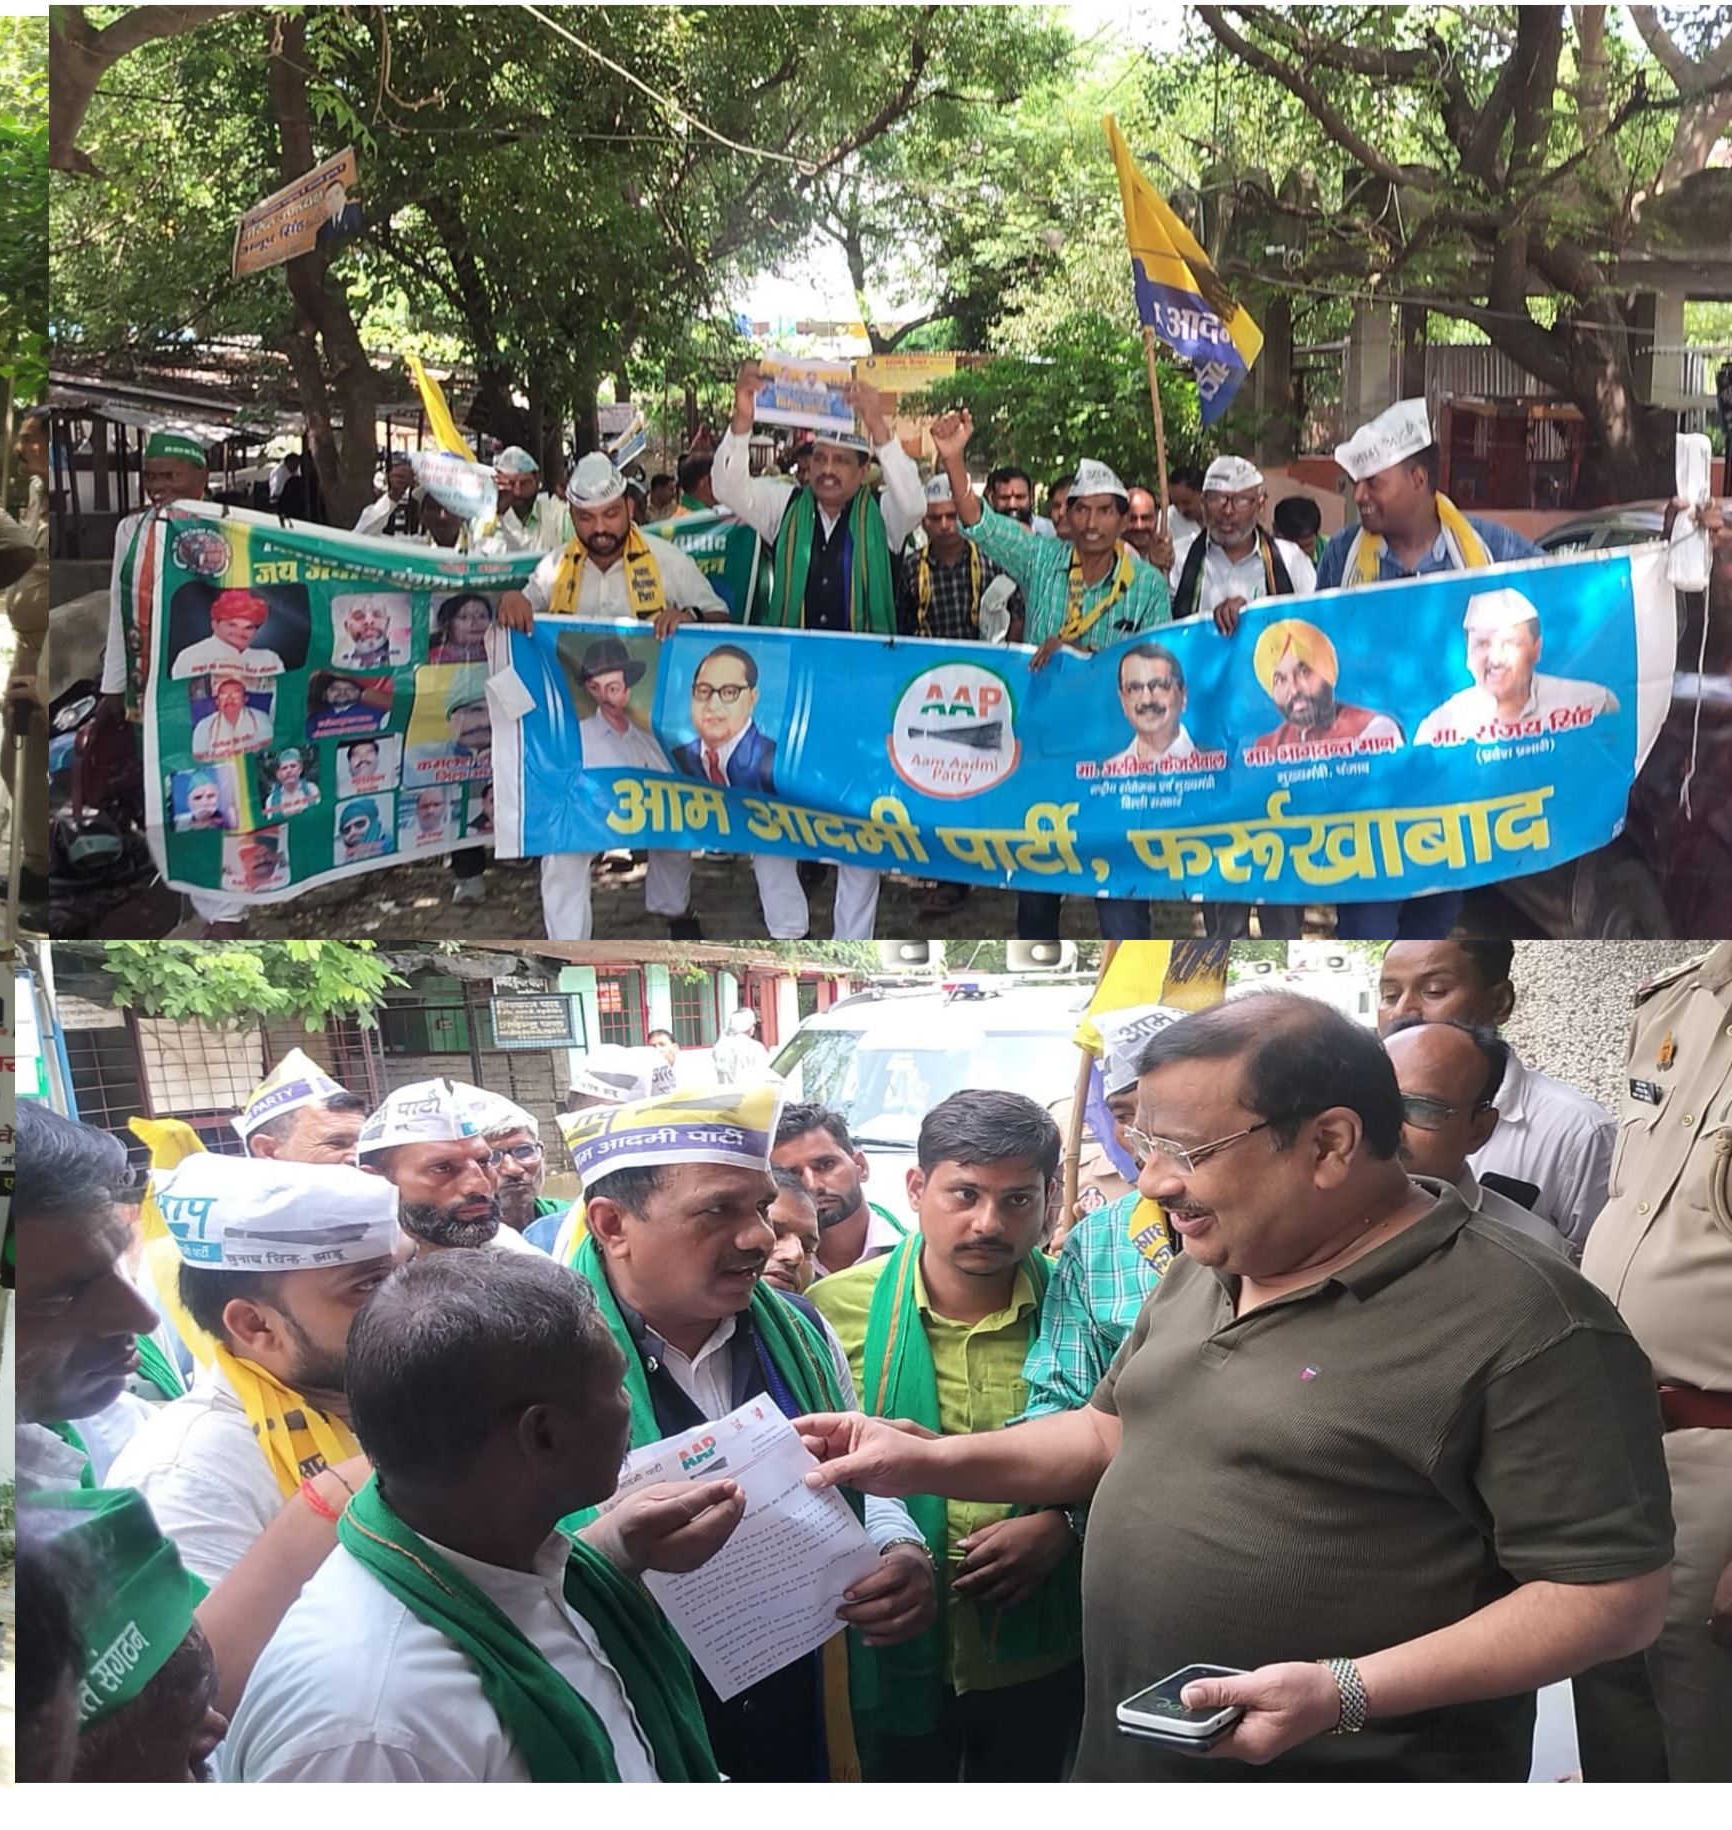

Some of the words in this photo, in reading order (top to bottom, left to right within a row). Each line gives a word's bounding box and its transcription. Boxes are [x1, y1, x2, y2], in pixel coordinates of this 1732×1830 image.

[253, 560, 299, 585] जय
[920, 683, 1003, 718] AAP
[1432, 726, 1467, 749] मा.
[1474, 717, 1544, 744] संजय
[1548, 706, 1596, 735] सिंह
[1358, 735, 1400, 756] मान
[910, 753, 946, 769] Aam
[949, 757, 999, 773] Aadmi
[932, 767, 972, 786] Party
[606, 779, 731, 836] आम
[744, 796, 930, 864] आदमी
[1118, 1012, 1175, 1044] आम
[251, 1087, 295, 1118] PARTY
[397, 1087, 442, 1116] पार्टी
[597, 1129, 679, 1155] आदमी
[687, 1128, 746, 1147] पार्टी
[226, 1253, 263, 1267] चुनाव
[678, 1434, 718, 1471] AAP
[89, 1620, 151, 1693] संगठन
